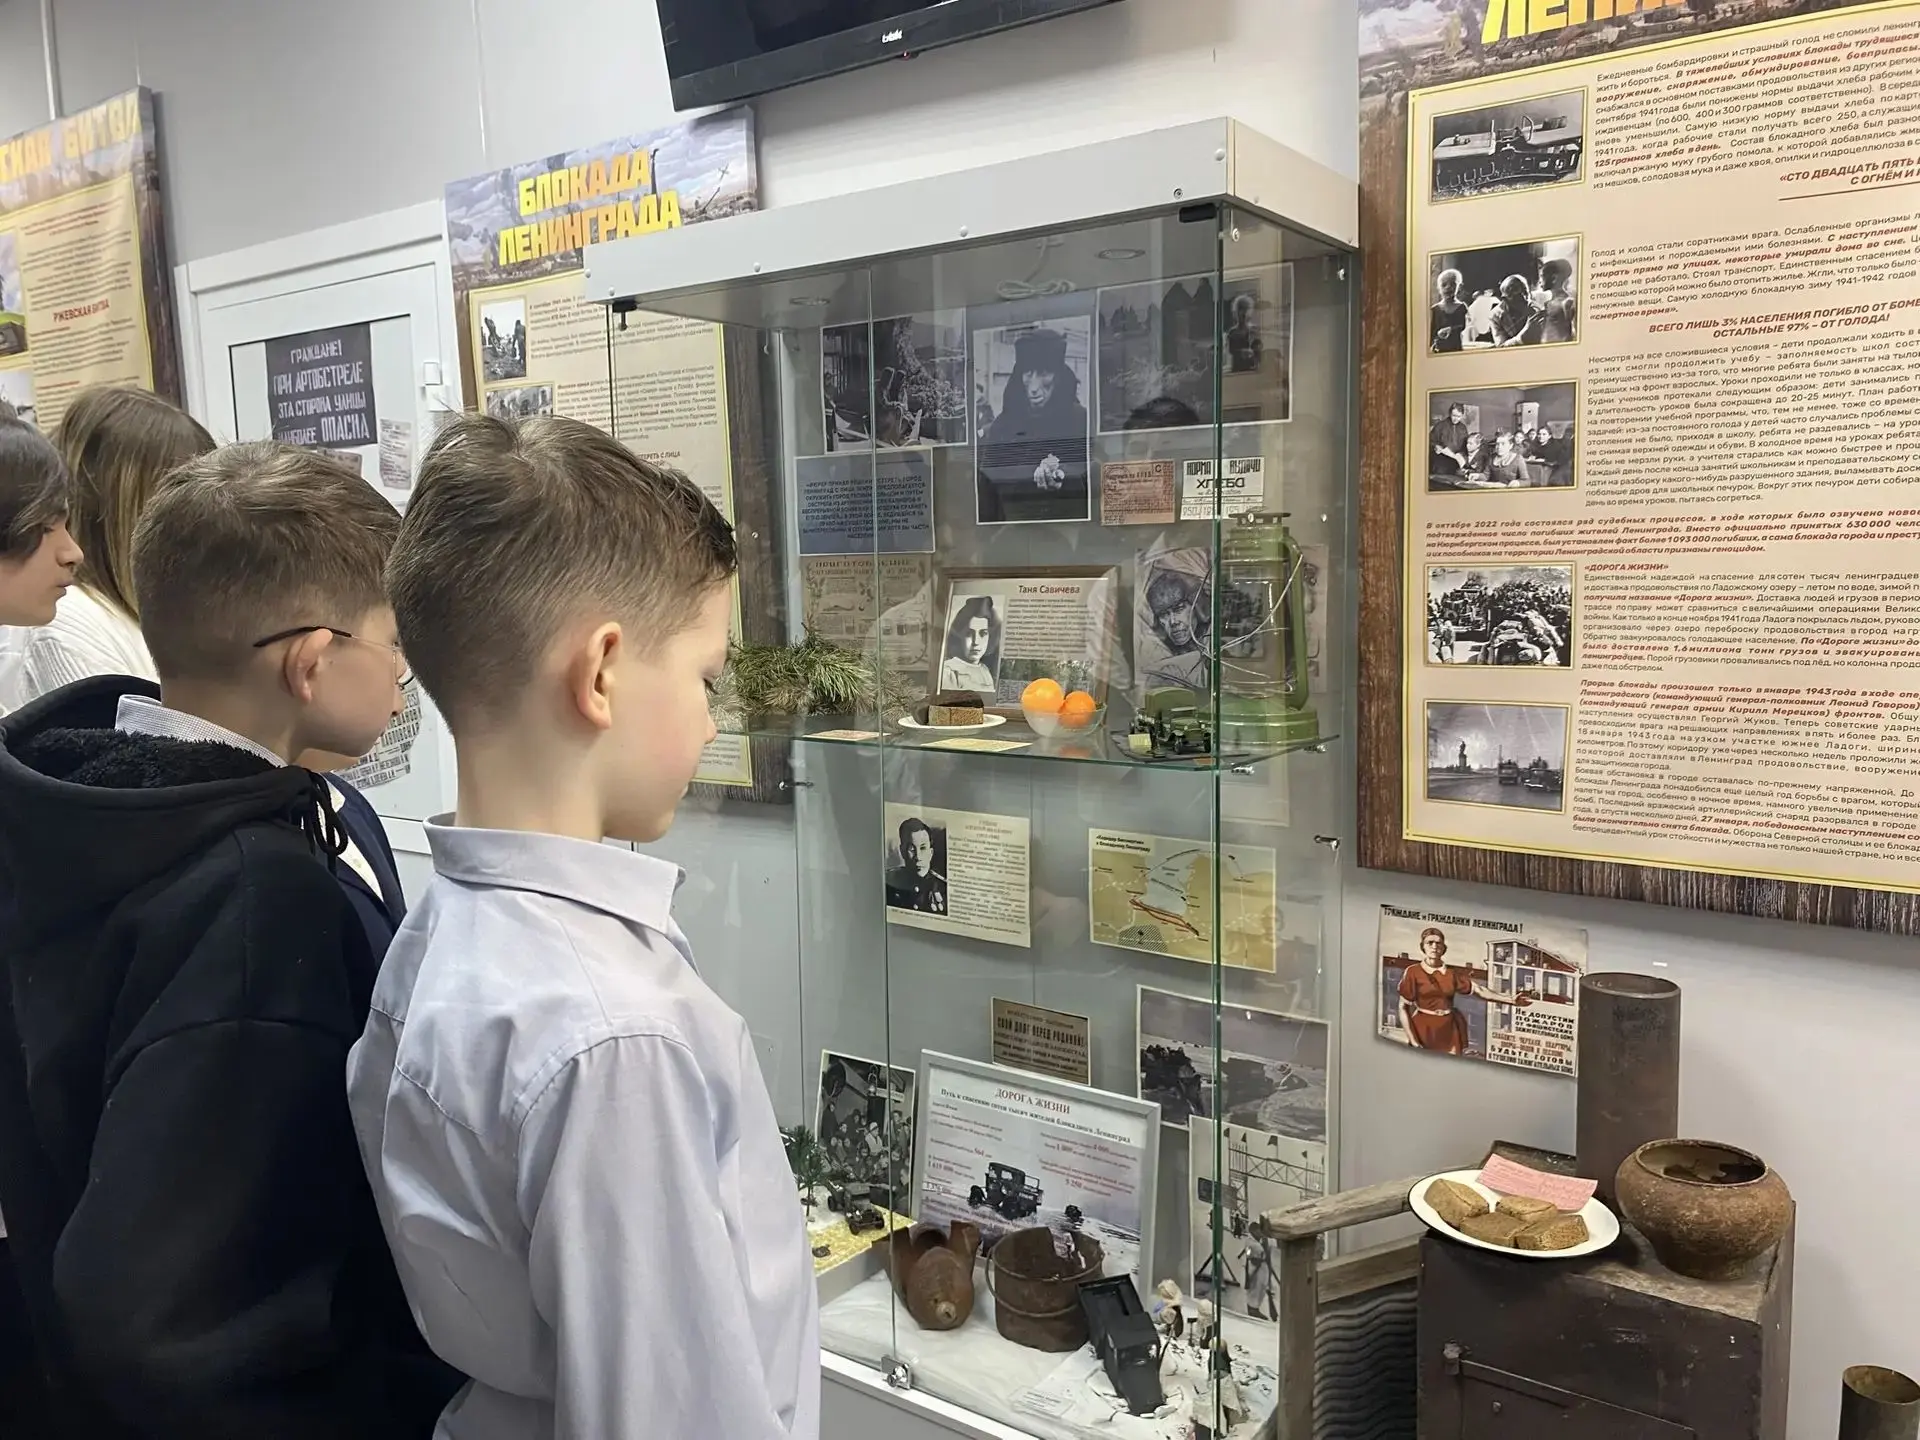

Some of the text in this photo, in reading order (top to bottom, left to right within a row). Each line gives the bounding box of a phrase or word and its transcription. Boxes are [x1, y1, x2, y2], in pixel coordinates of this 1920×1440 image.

[1597, 64, 1653, 82] Ежедневные
[1656, 50, 1729, 71] бомбардировки
[1739, 40, 1788, 56] страшный
[1792, 34, 1820, 46] голод
[1836, 24, 1879, 38] сломили
[1596, 82, 1618, 92] жить
[1627, 71, 1671, 87] бороться.
[1686, 57, 1750, 76] тяжелейших
[1752, 50, 1801, 66] условиях
[1804, 40, 1851, 55] блокады
[1596, 86, 1661, 104] вооружение,
[1666, 73, 1736, 92] снаряжение,
[1741, 54, 1840, 78] обмундирование,
[1594, 158, 1610, 167] 125
[1611, 153, 1651, 165] граммов
[1654, 146, 1684, 158] хлеба
[1694, 141, 1720, 152] день.
[1730, 134, 1764, 147] Состав
[1768, 125, 1825, 142] блокадного
[1829, 121, 1858, 133] хлеба
[1863, 117, 1883, 129] был
[1811, 161, 1878, 180] ДВАДЦАТЬ
[1881, 157, 1913, 169] ПЯТЬ
[1861, 169, 1902, 184] ОГНЁМ
[519, 150, 651, 216] БЛОКАДА
[499, 190, 681, 265] ЛЕНИНГРАДА
[1590, 268, 1629, 280] умирать
[1633, 264, 1663, 275] прямо
[1682, 258, 1720, 270] улицах,
[1725, 252, 1781, 265] некоторые
[1785, 246, 1831, 259] умирали
[1835, 241, 1862, 252] дома
[1883, 238, 1905, 246] сне.
[53, 304, 91, 322] РЖЕВСКАЯ
[1640, 306, 1677, 317] время».
[1649, 321, 1683, 333] ВСЕГО
[1685, 318, 1719, 330] ЛИШЬ
[1740, 310, 1811, 325] НАСЕЛЕНИЯ
[1813, 304, 1869, 318] ПОГИБЛО
[1713, 323, 1784, 338] ОСТАЛЬНЫЕ
[1787, 321, 1808, 332] 97%
[1837, 313, 1889, 327] ГОЛОДА!
[290, 339, 342, 364] ГРАЖДАНЕ!
[1588, 353, 1630, 365] Несмотря
[1646, 351, 1662, 360] все
[1664, 346, 1728, 358] сложившиеся
[1731, 343, 1769, 353] условия
[1781, 340, 1804, 349] дети
[1806, 334, 1867, 346] продолжали
[1871, 330, 1905, 340] ходить
[273, 361, 363, 396] ПРИ АРТОБСТРЕЛЕ
[278, 391, 366, 418] ЭТА СТОРОНА УЛИЦЫ
[321, 413, 370, 442] ОПАСНА
[1186, 459, 1261, 475] НОРМА ВЫДАЧИ
[1530, 528, 1573, 536] погибших
[1578, 526, 1618, 534] жителей
[1622, 525, 1680, 534] Ленинграда.
[1685, 524, 1720, 532] Вместо
[1724, 523, 1785, 532] официально
[1790, 522, 1842, 531] принятых
[1584, 563, 1625, 571] «ДОРОГА
[1019, 585, 1080, 594] Таня Савичева
[1618, 680, 1657, 689] блокады
[1660, 683, 1713, 692] произошел
[1763, 687, 1800, 696] январе
[1806, 686, 1831, 695] 1943
[1832, 687, 1856, 696] года
[1868, 688, 1894, 697] ходе
[1652, 691, 1722, 703] (командующий
[1726, 696, 1825, 707] генерал-полковник
[1828, 698, 1868, 708] Леонид
[1384, 907, 1421, 920] ГРАЖДАНЕ
[1427, 913, 1470, 927] ГРАЖДАНКИ
[1528, 1012, 1575, 1024] ДОПУСТИМ
[1490, 1045, 1528, 1058] БУДЬТЕ
[1534, 1054, 1572, 1066] ГОТОВЫ
[941, 1088, 956, 1098] Путь
[995, 1087, 1070, 1115] ДОРОГА ЖИЗНИ
